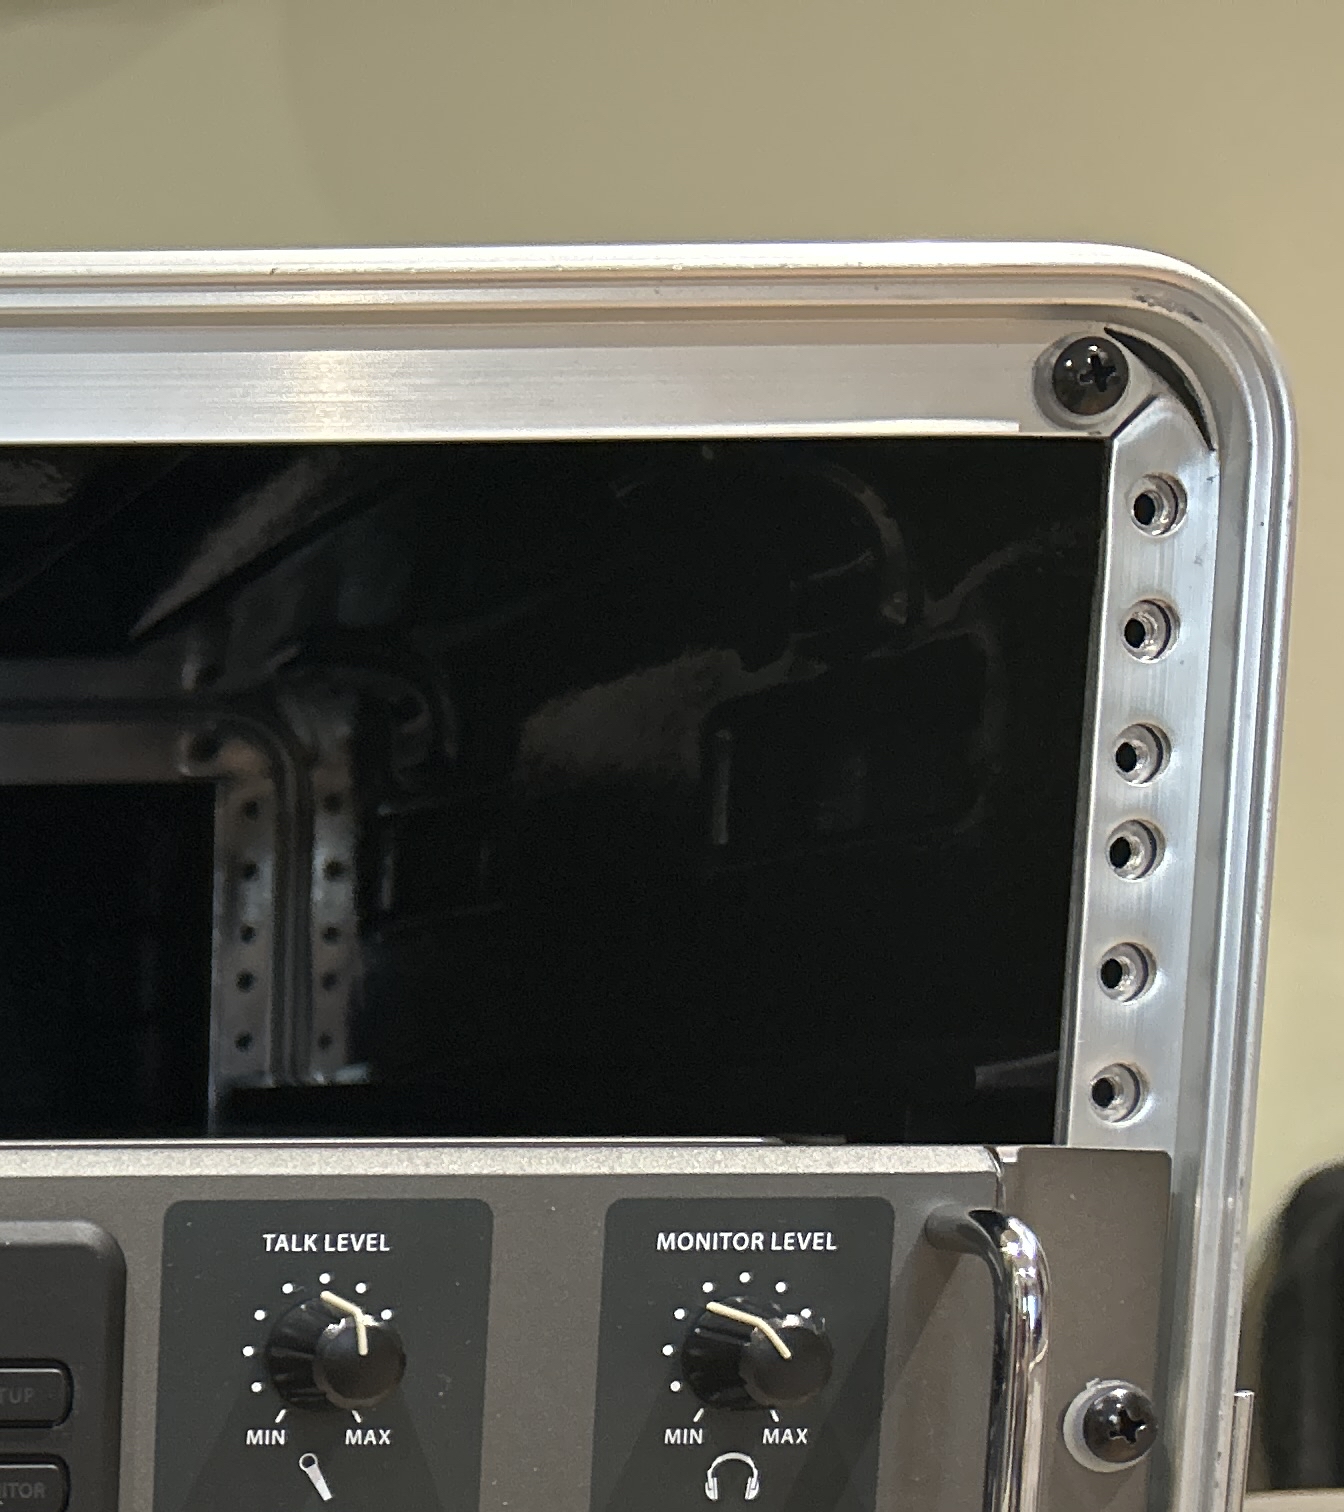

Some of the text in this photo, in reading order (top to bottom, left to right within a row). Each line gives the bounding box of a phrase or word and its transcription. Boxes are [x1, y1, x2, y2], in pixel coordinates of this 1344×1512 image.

[263, 1234, 390, 1251] TALK LEVEL
[657, 1232, 837, 1250] MONITOR LEVEL
[247, 1430, 285, 1445] MIN
[346, 1430, 390, 1444] MAX
[665, 1429, 702, 1444] MIN
[763, 1429, 807, 1444] MAX
